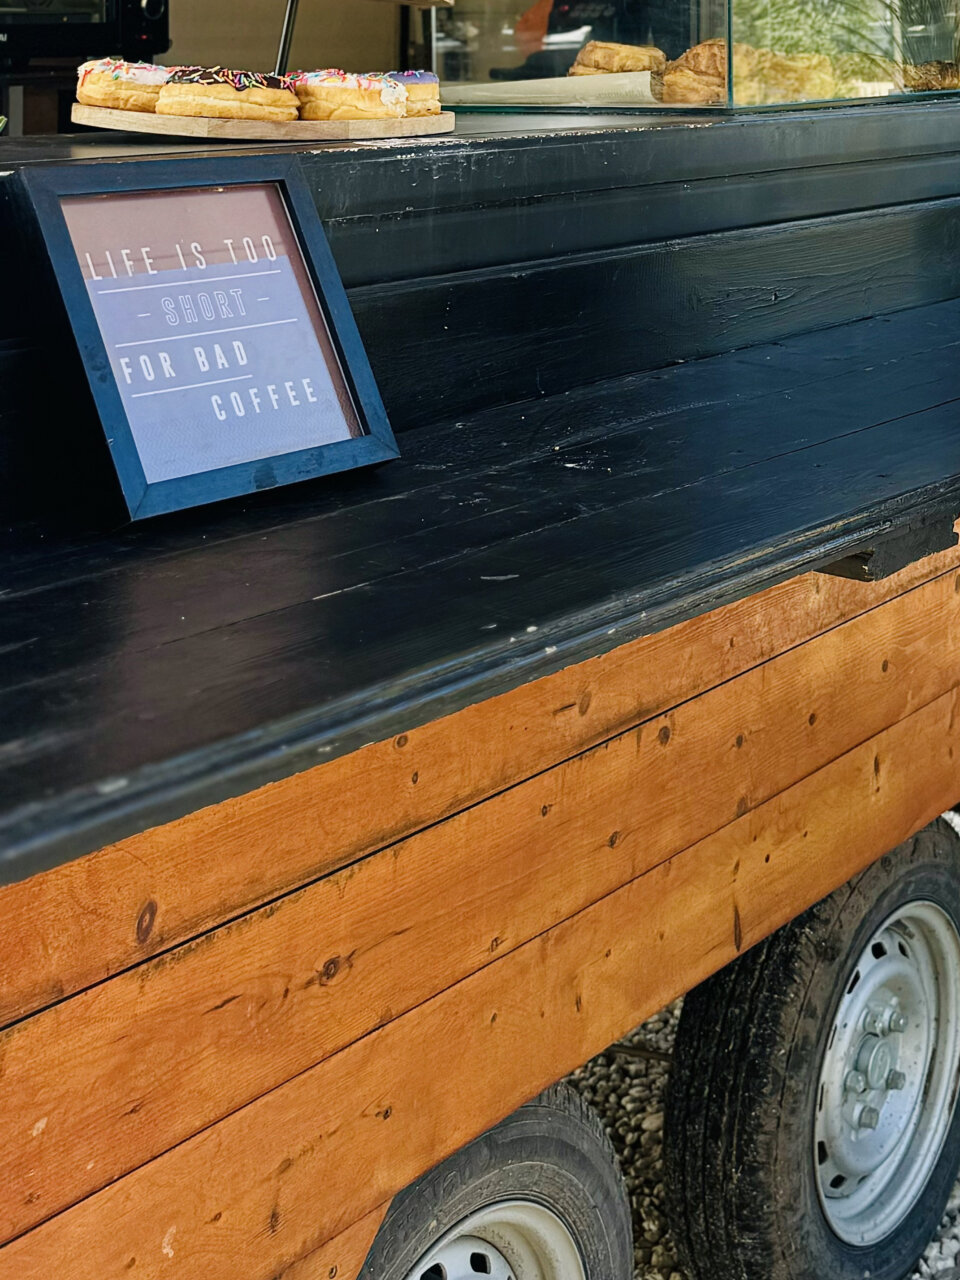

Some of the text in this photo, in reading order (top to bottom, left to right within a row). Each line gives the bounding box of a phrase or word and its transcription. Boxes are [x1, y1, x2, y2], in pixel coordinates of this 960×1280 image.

[85, 235, 277, 281] LIFE IS TOO
[161, 288, 247, 326] SHORT
[119, 340, 248, 384] FOR BAD
[211, 378, 317, 421] COFFEE
